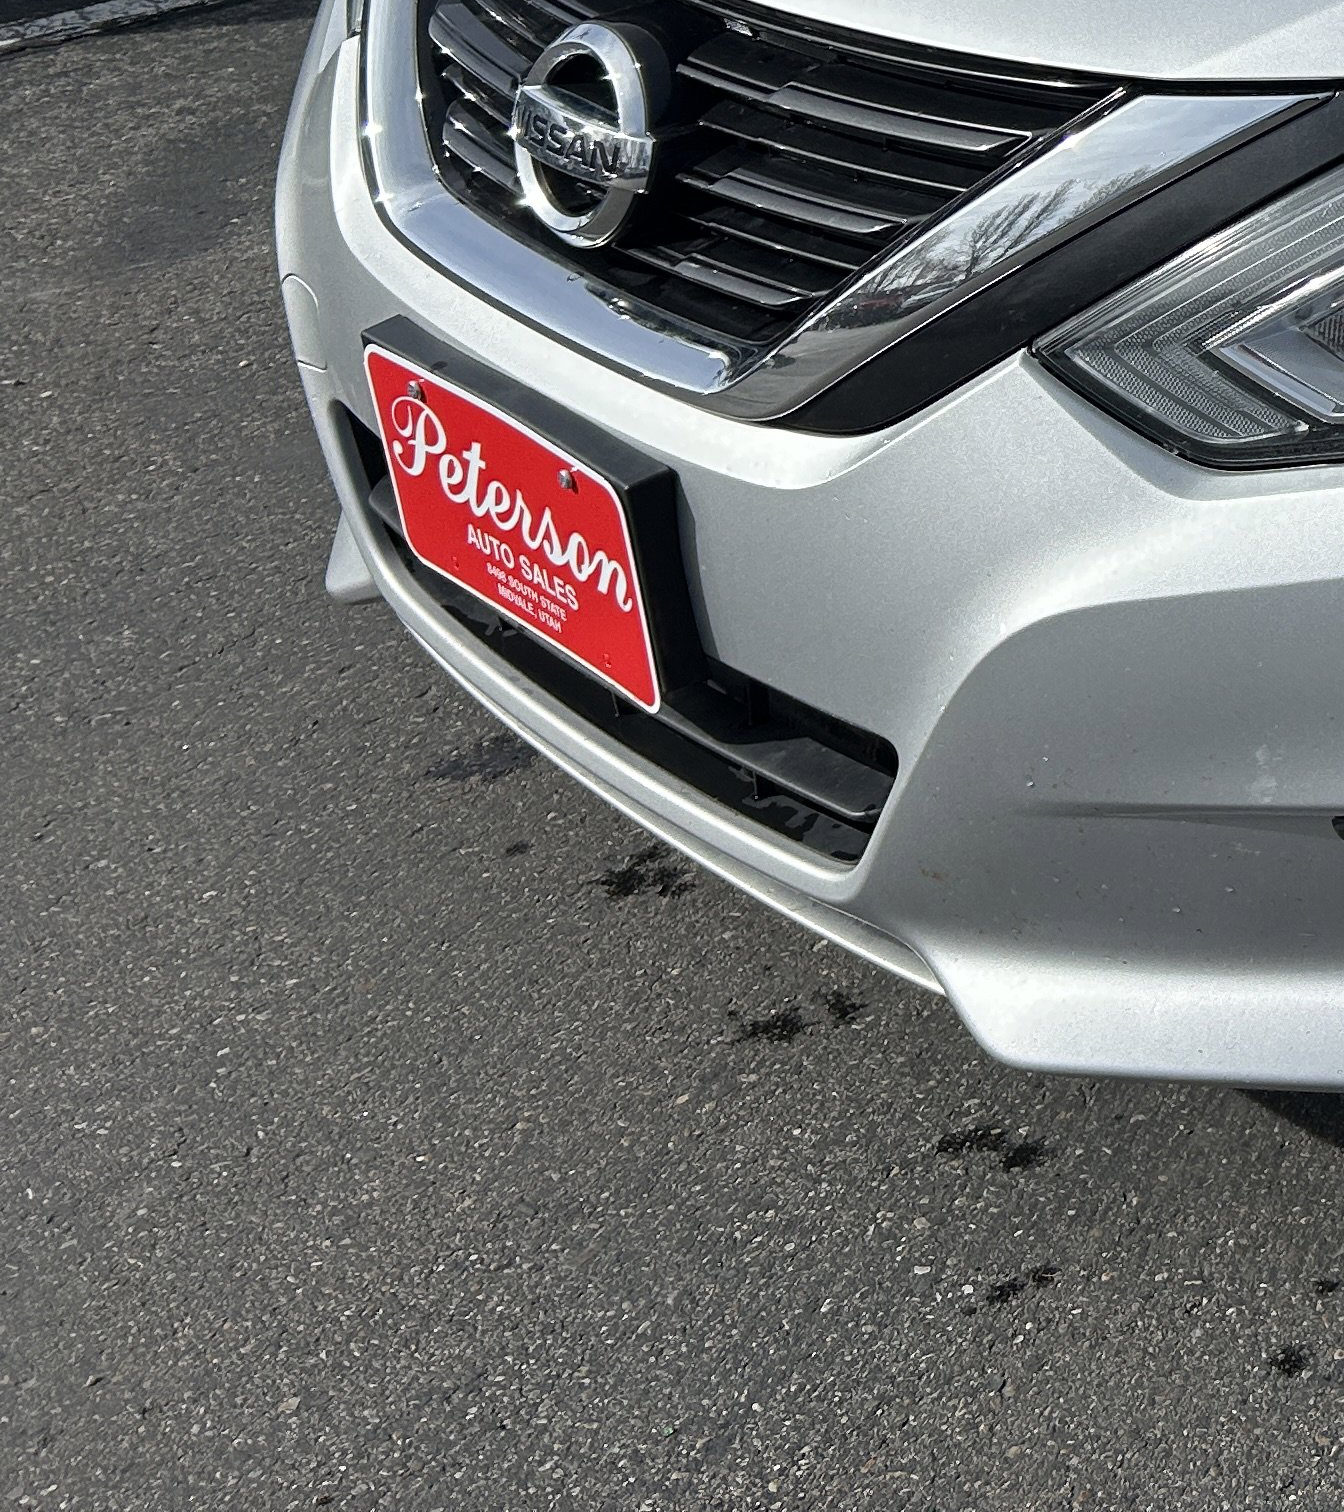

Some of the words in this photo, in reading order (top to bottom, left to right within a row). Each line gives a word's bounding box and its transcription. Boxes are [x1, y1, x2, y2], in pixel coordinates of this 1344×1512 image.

[391, 395, 632, 613] Peterson
[467, 523, 515, 569] AUTO
[519, 554, 579, 611] SALES
[507, 575, 539, 603] SOUTH
[540, 595, 567, 621] STATE
[538, 608, 562, 633] UTAH
